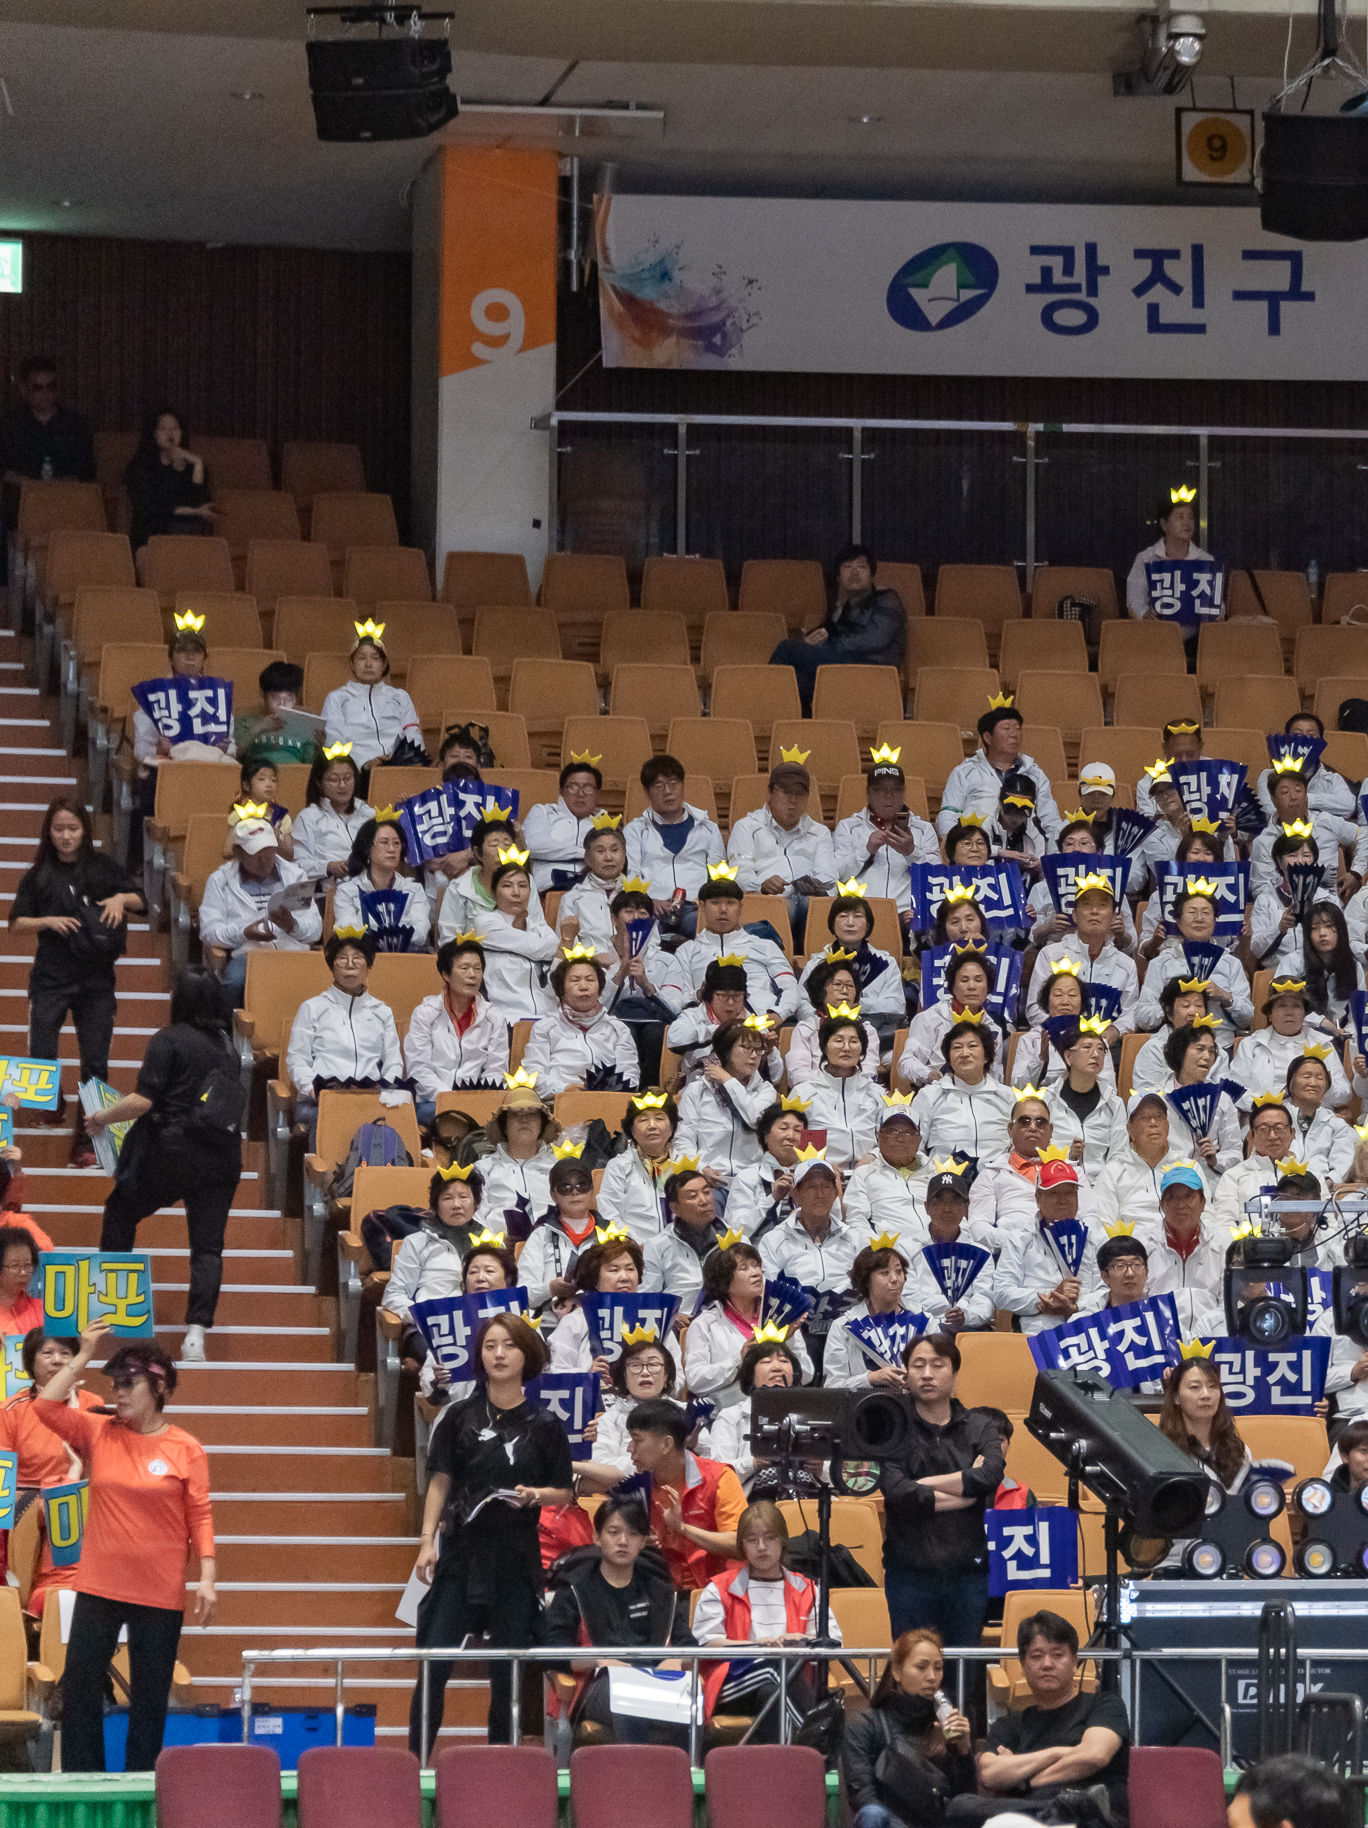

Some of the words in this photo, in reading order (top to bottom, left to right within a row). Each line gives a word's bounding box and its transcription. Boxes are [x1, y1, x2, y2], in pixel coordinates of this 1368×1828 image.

[1206, 133, 1228, 163] 9
[1025, 242, 1316, 336] 광진구
[470, 287, 526, 364] 9
[1151, 570, 1223, 615] 광진
[148, 688, 228, 738] 광진
[874, 767, 900, 777] PING
[44, 1259, 149, 1333] 마포
[1059, 1311, 1166, 1378] 광진
[1214, 1349, 1312, 1408] 광진
